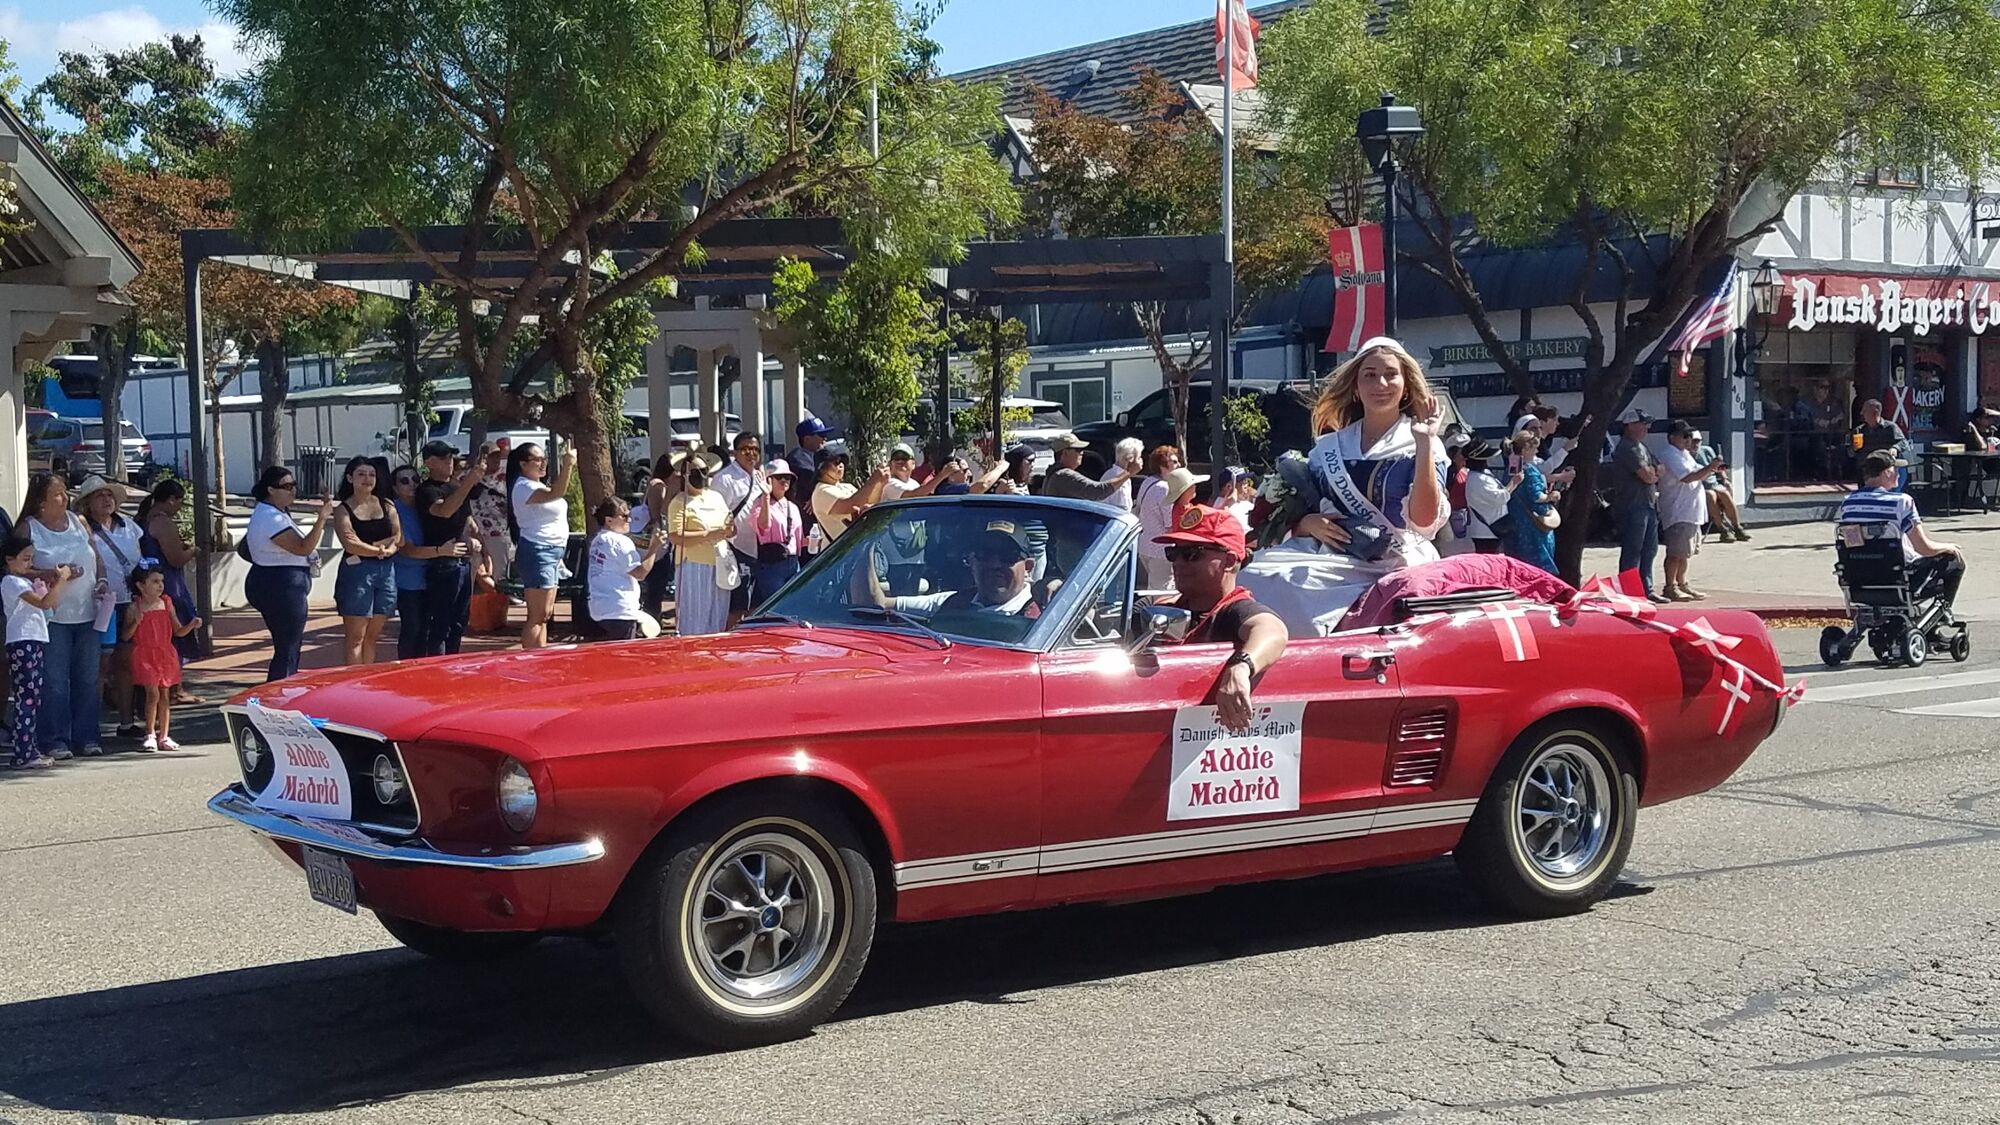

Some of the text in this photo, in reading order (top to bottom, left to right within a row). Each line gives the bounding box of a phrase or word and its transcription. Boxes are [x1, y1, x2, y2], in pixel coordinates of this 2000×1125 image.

[1340, 268, 1382, 291] Solvang
[1788, 277, 1876, 332] Dansk
[1877, 279, 1964, 336] Bageri
[1526, 339, 1583, 357] BAKERY
[1325, 449, 1377, 521] 2025 Danish
[1179, 726, 1224, 743] Danish
[1263, 721, 1296, 738] Maid
[284, 742, 330, 769] Addie
[1200, 744, 1274, 774] Addie
[276, 774, 340, 805] Madrid
[1188, 775, 1280, 807] Madrid
[972, 858, 1010, 871] GT
